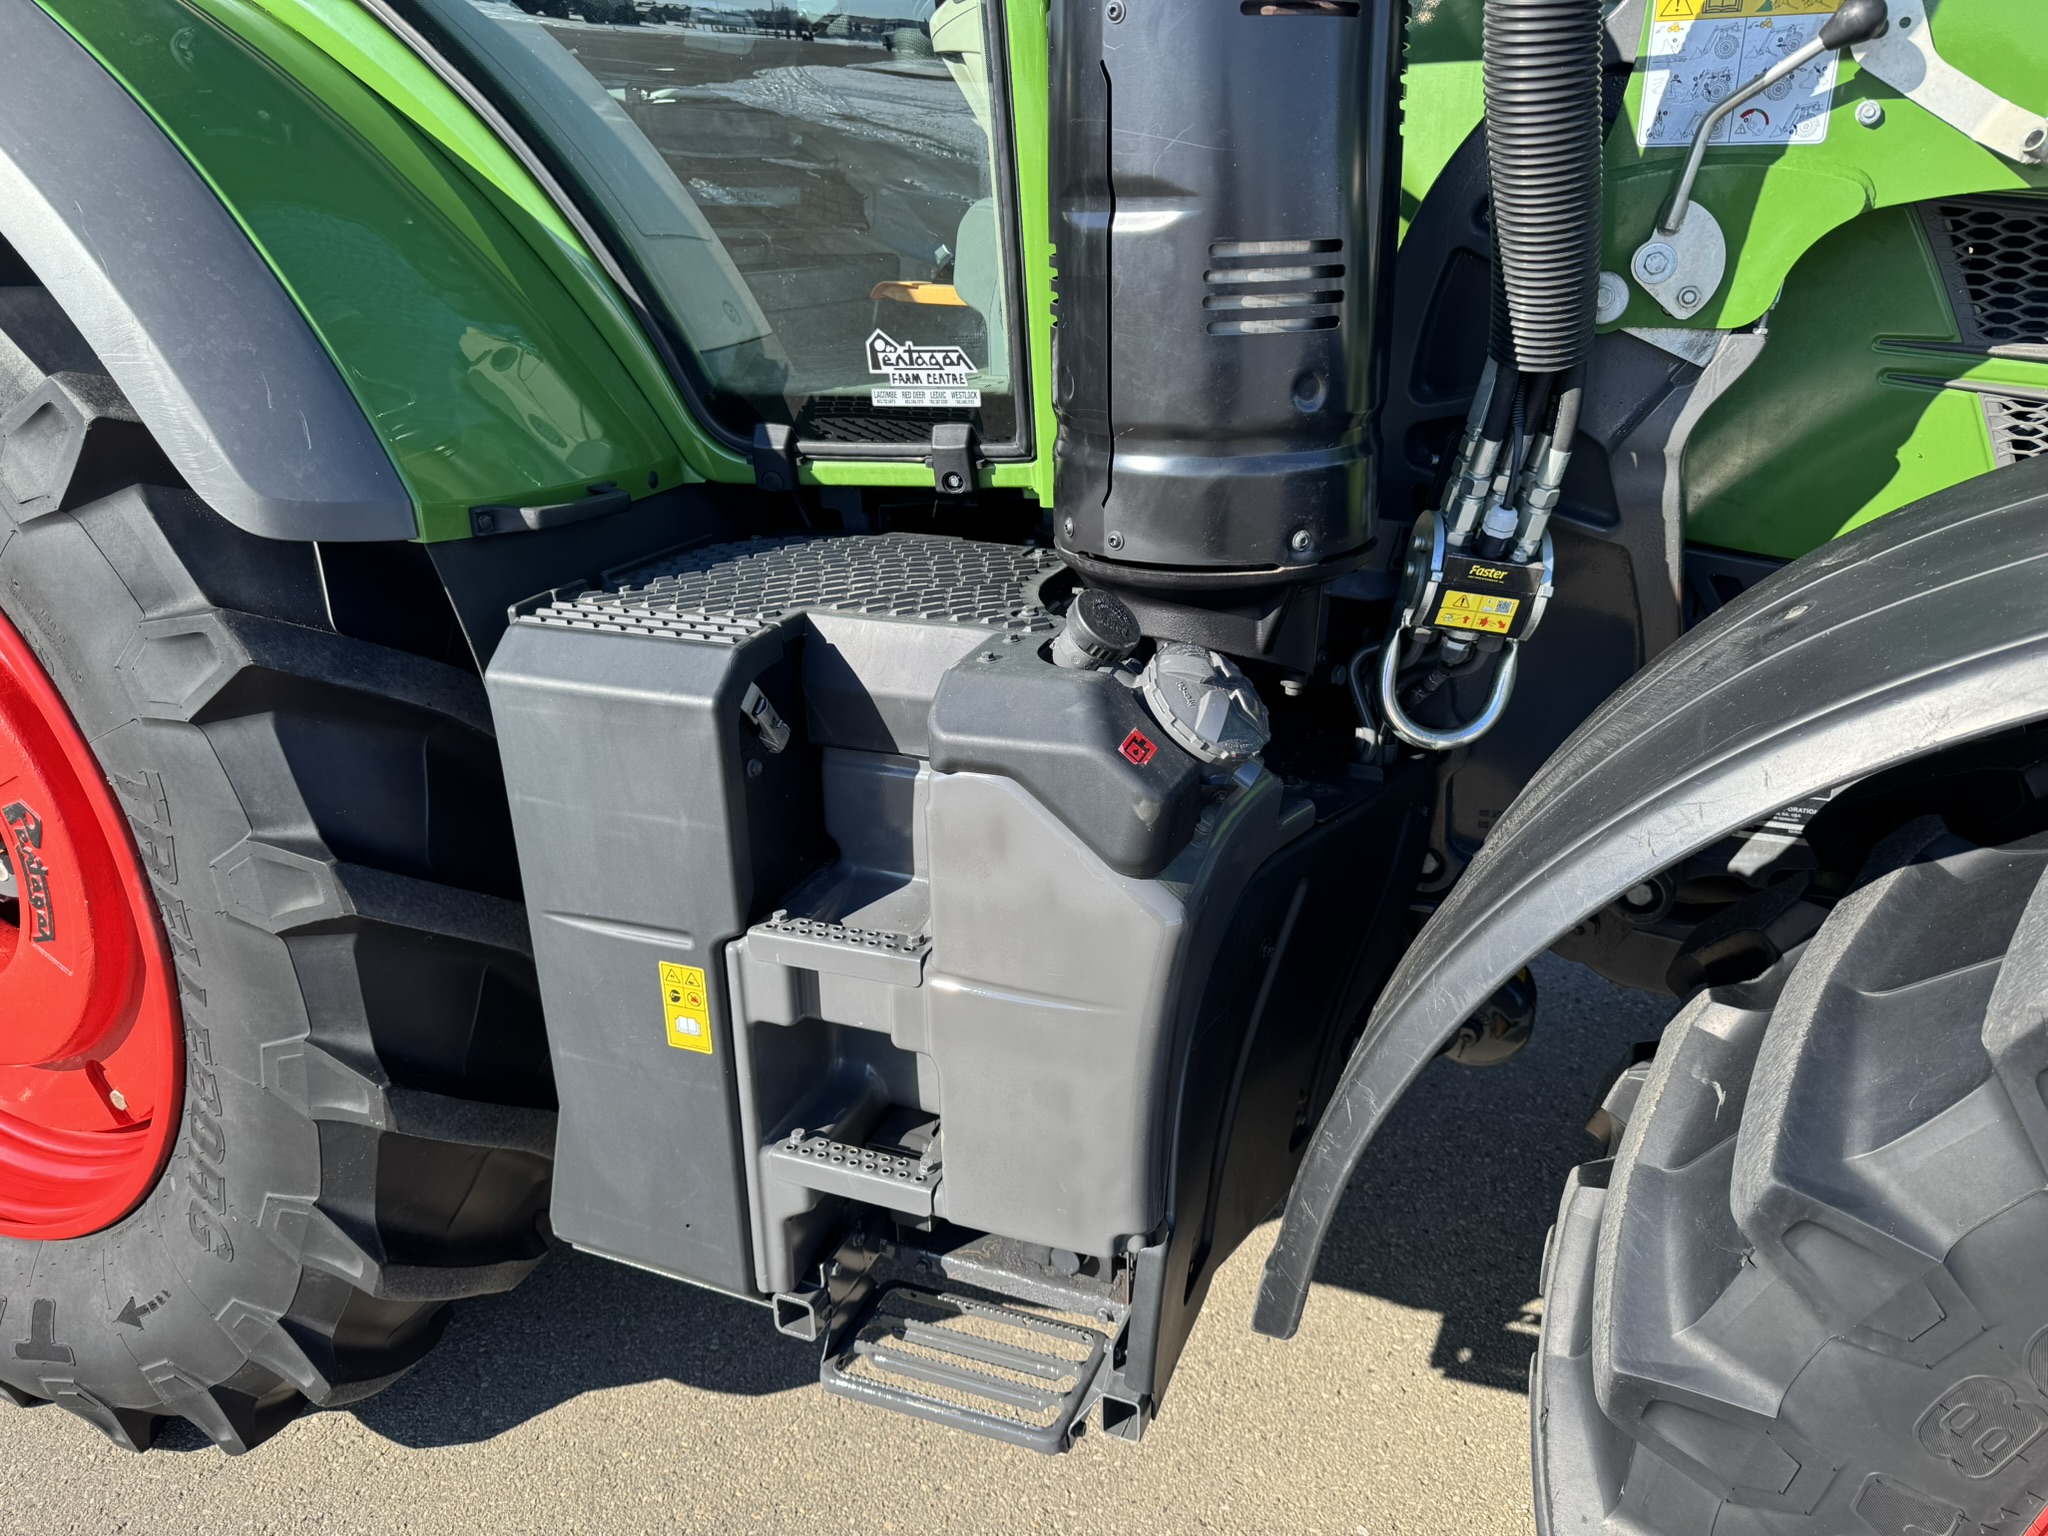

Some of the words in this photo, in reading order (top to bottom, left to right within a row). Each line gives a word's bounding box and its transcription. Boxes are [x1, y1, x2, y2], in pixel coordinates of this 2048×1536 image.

[892, 373, 922, 384] FARM
[926, 373, 966, 384] CENTRE
[873, 391, 898, 399] LACOMBE
[901, 391, 912, 399] RED
[912, 391, 926, 399] DEER
[929, 391, 947, 399] LEDUC
[950, 391, 978, 399] WESTLOCK
[1469, 565, 1508, 580] Faster
[114, 771, 236, 1264] TRELLEBORG
